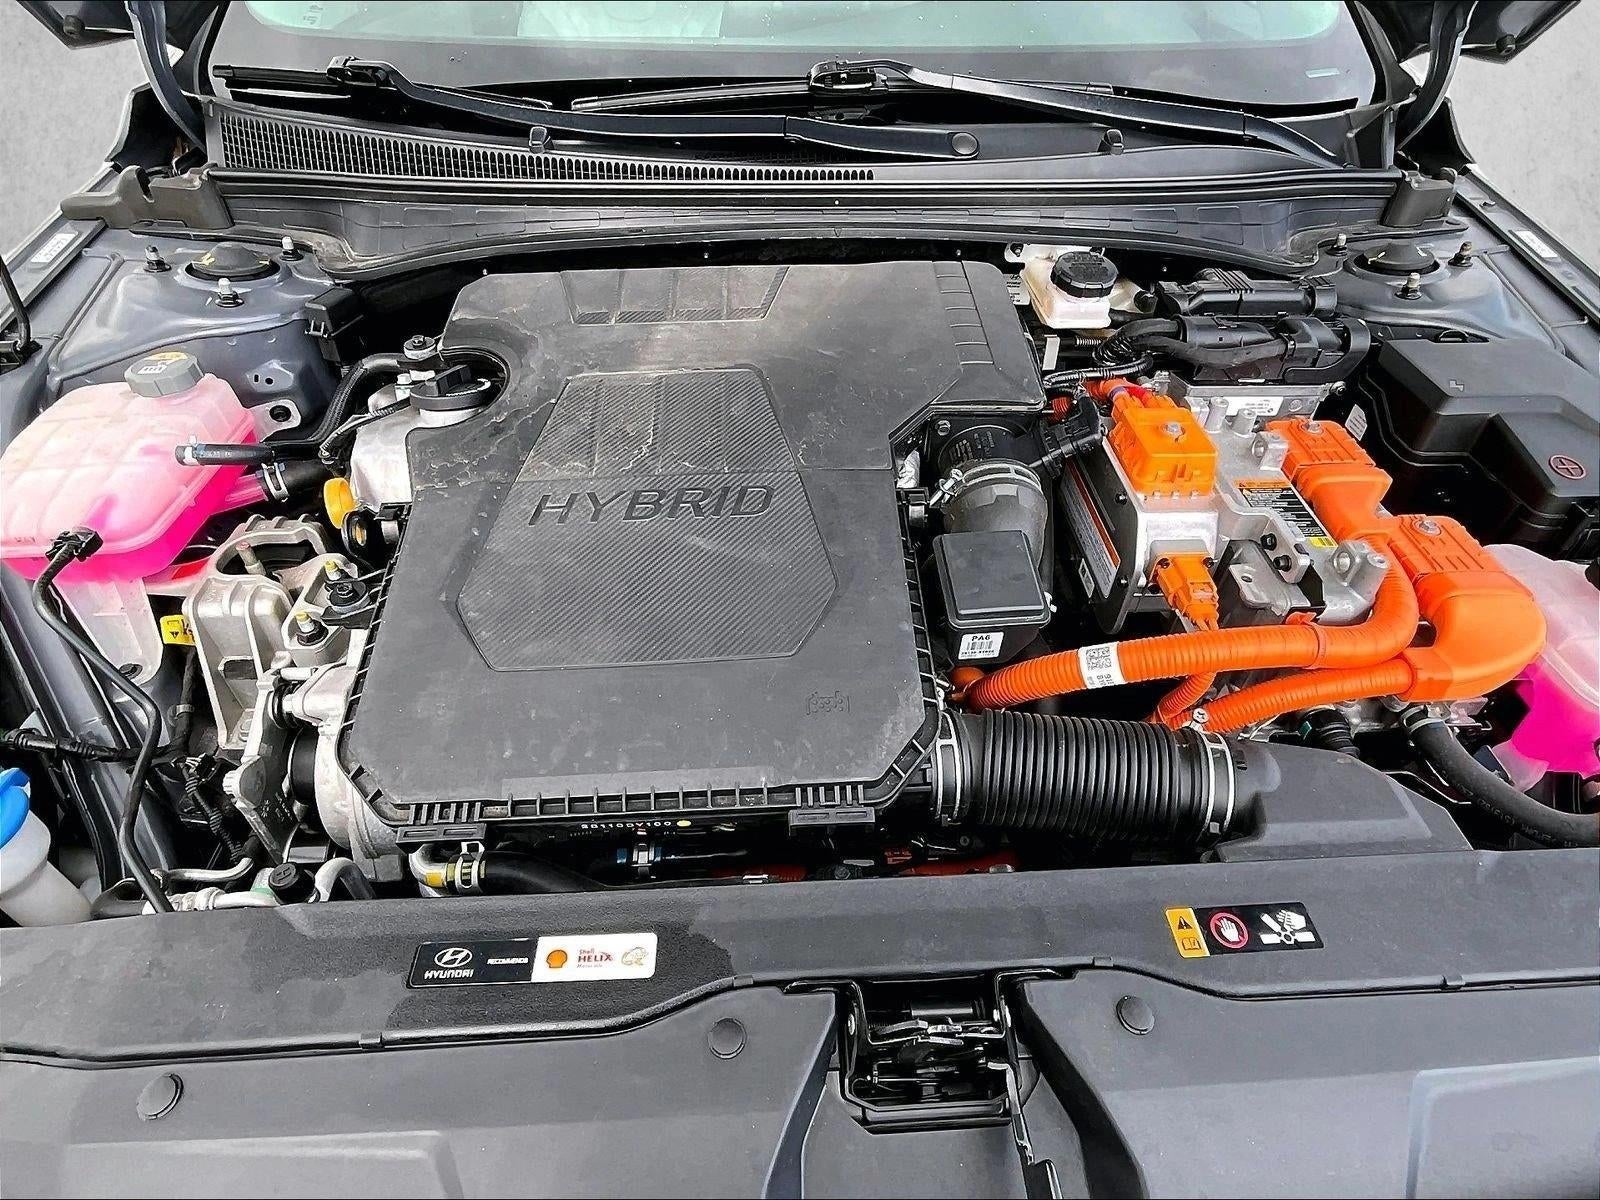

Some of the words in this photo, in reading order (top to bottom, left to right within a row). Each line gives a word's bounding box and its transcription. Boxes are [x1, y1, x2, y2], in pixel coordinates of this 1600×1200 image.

[528, 485, 775, 527] HYBRID
[578, 953, 613, 963] HELIX
[424, 969, 475, 979] HYUNDAI
